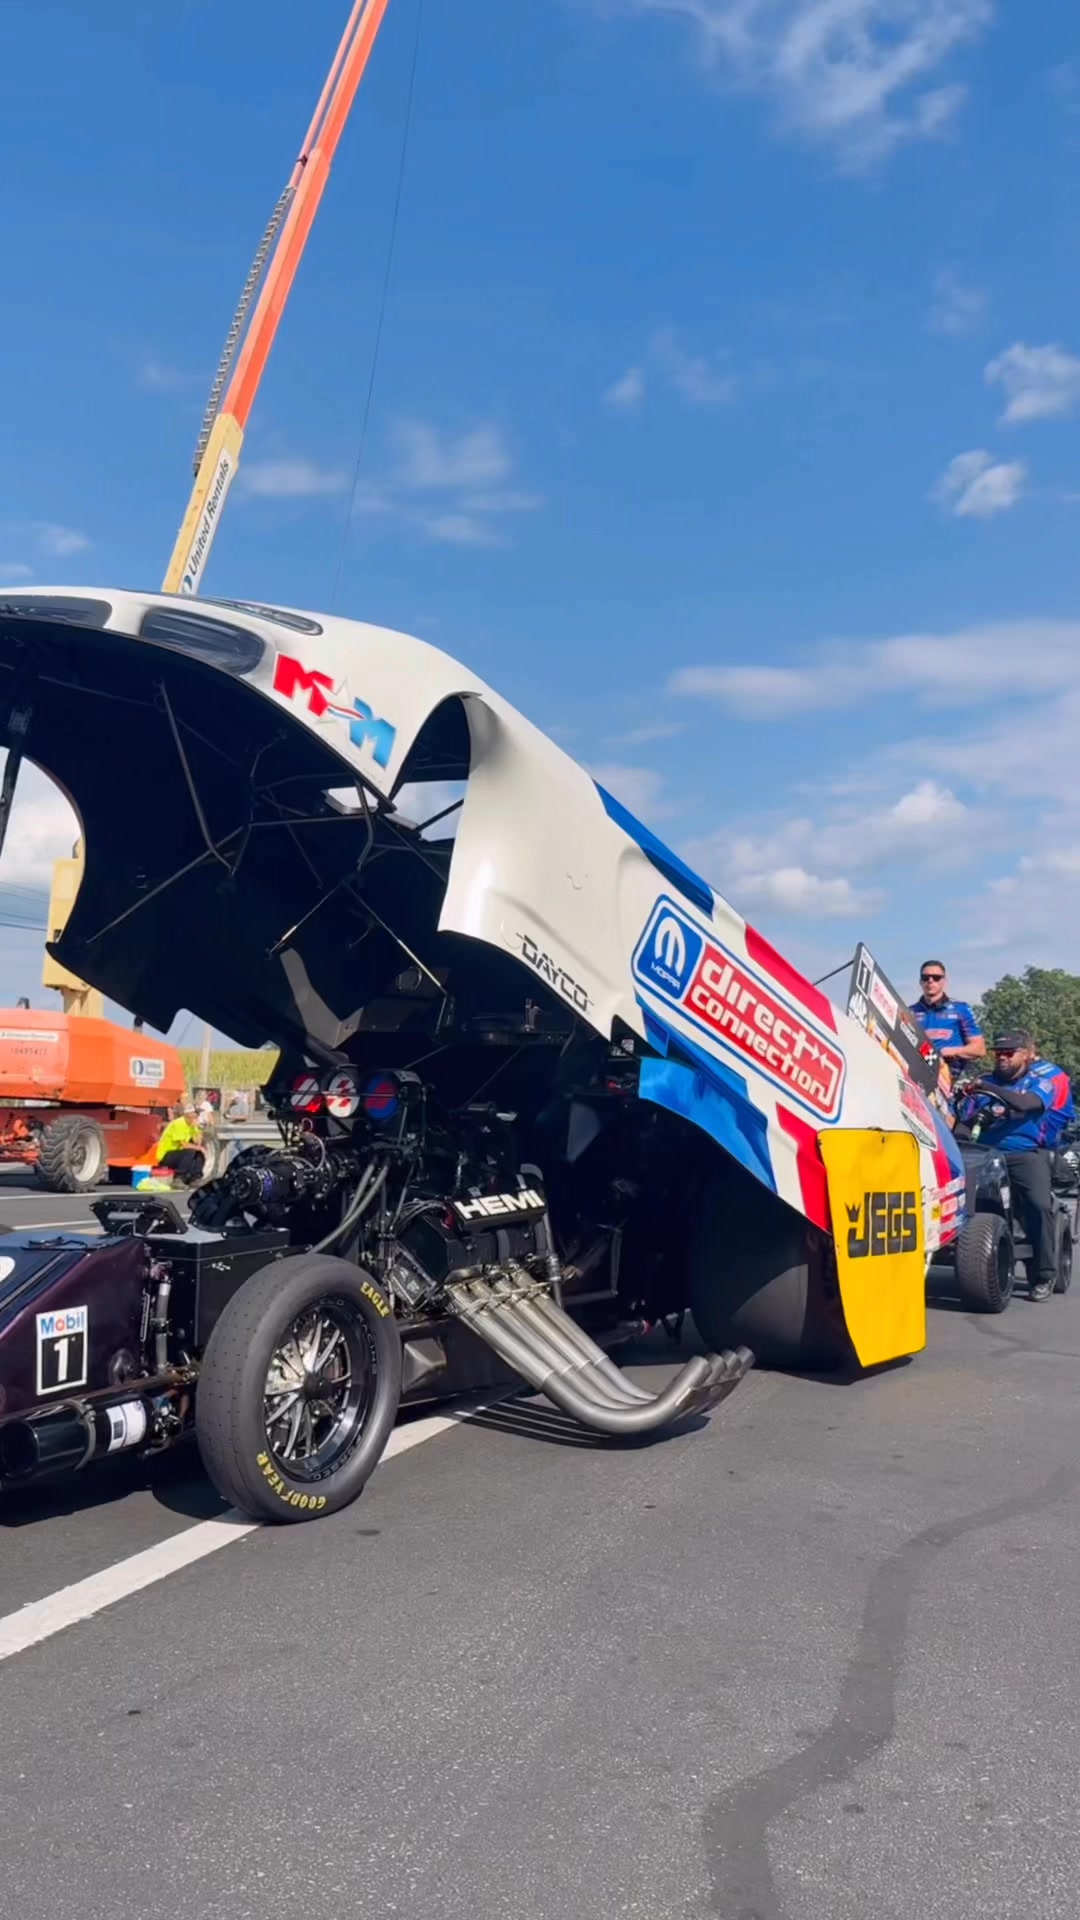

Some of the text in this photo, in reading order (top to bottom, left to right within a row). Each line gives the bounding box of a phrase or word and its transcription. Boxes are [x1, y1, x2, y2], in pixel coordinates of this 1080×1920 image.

[188, 459, 229, 576] United Rentals
[519, 933, 591, 1012] DAYCO
[650, 961, 681, 991] MOPAR
[701, 959, 813, 1059] direct
[691, 984, 833, 1105] connection
[453, 1189, 545, 1219] HEMI
[847, 1191, 918, 1258] JEGS
[41, 1312, 84, 1335] Mobil
[359, 1281, 390, 1318] EAGLE
[54, 1338, 69, 1382] 1
